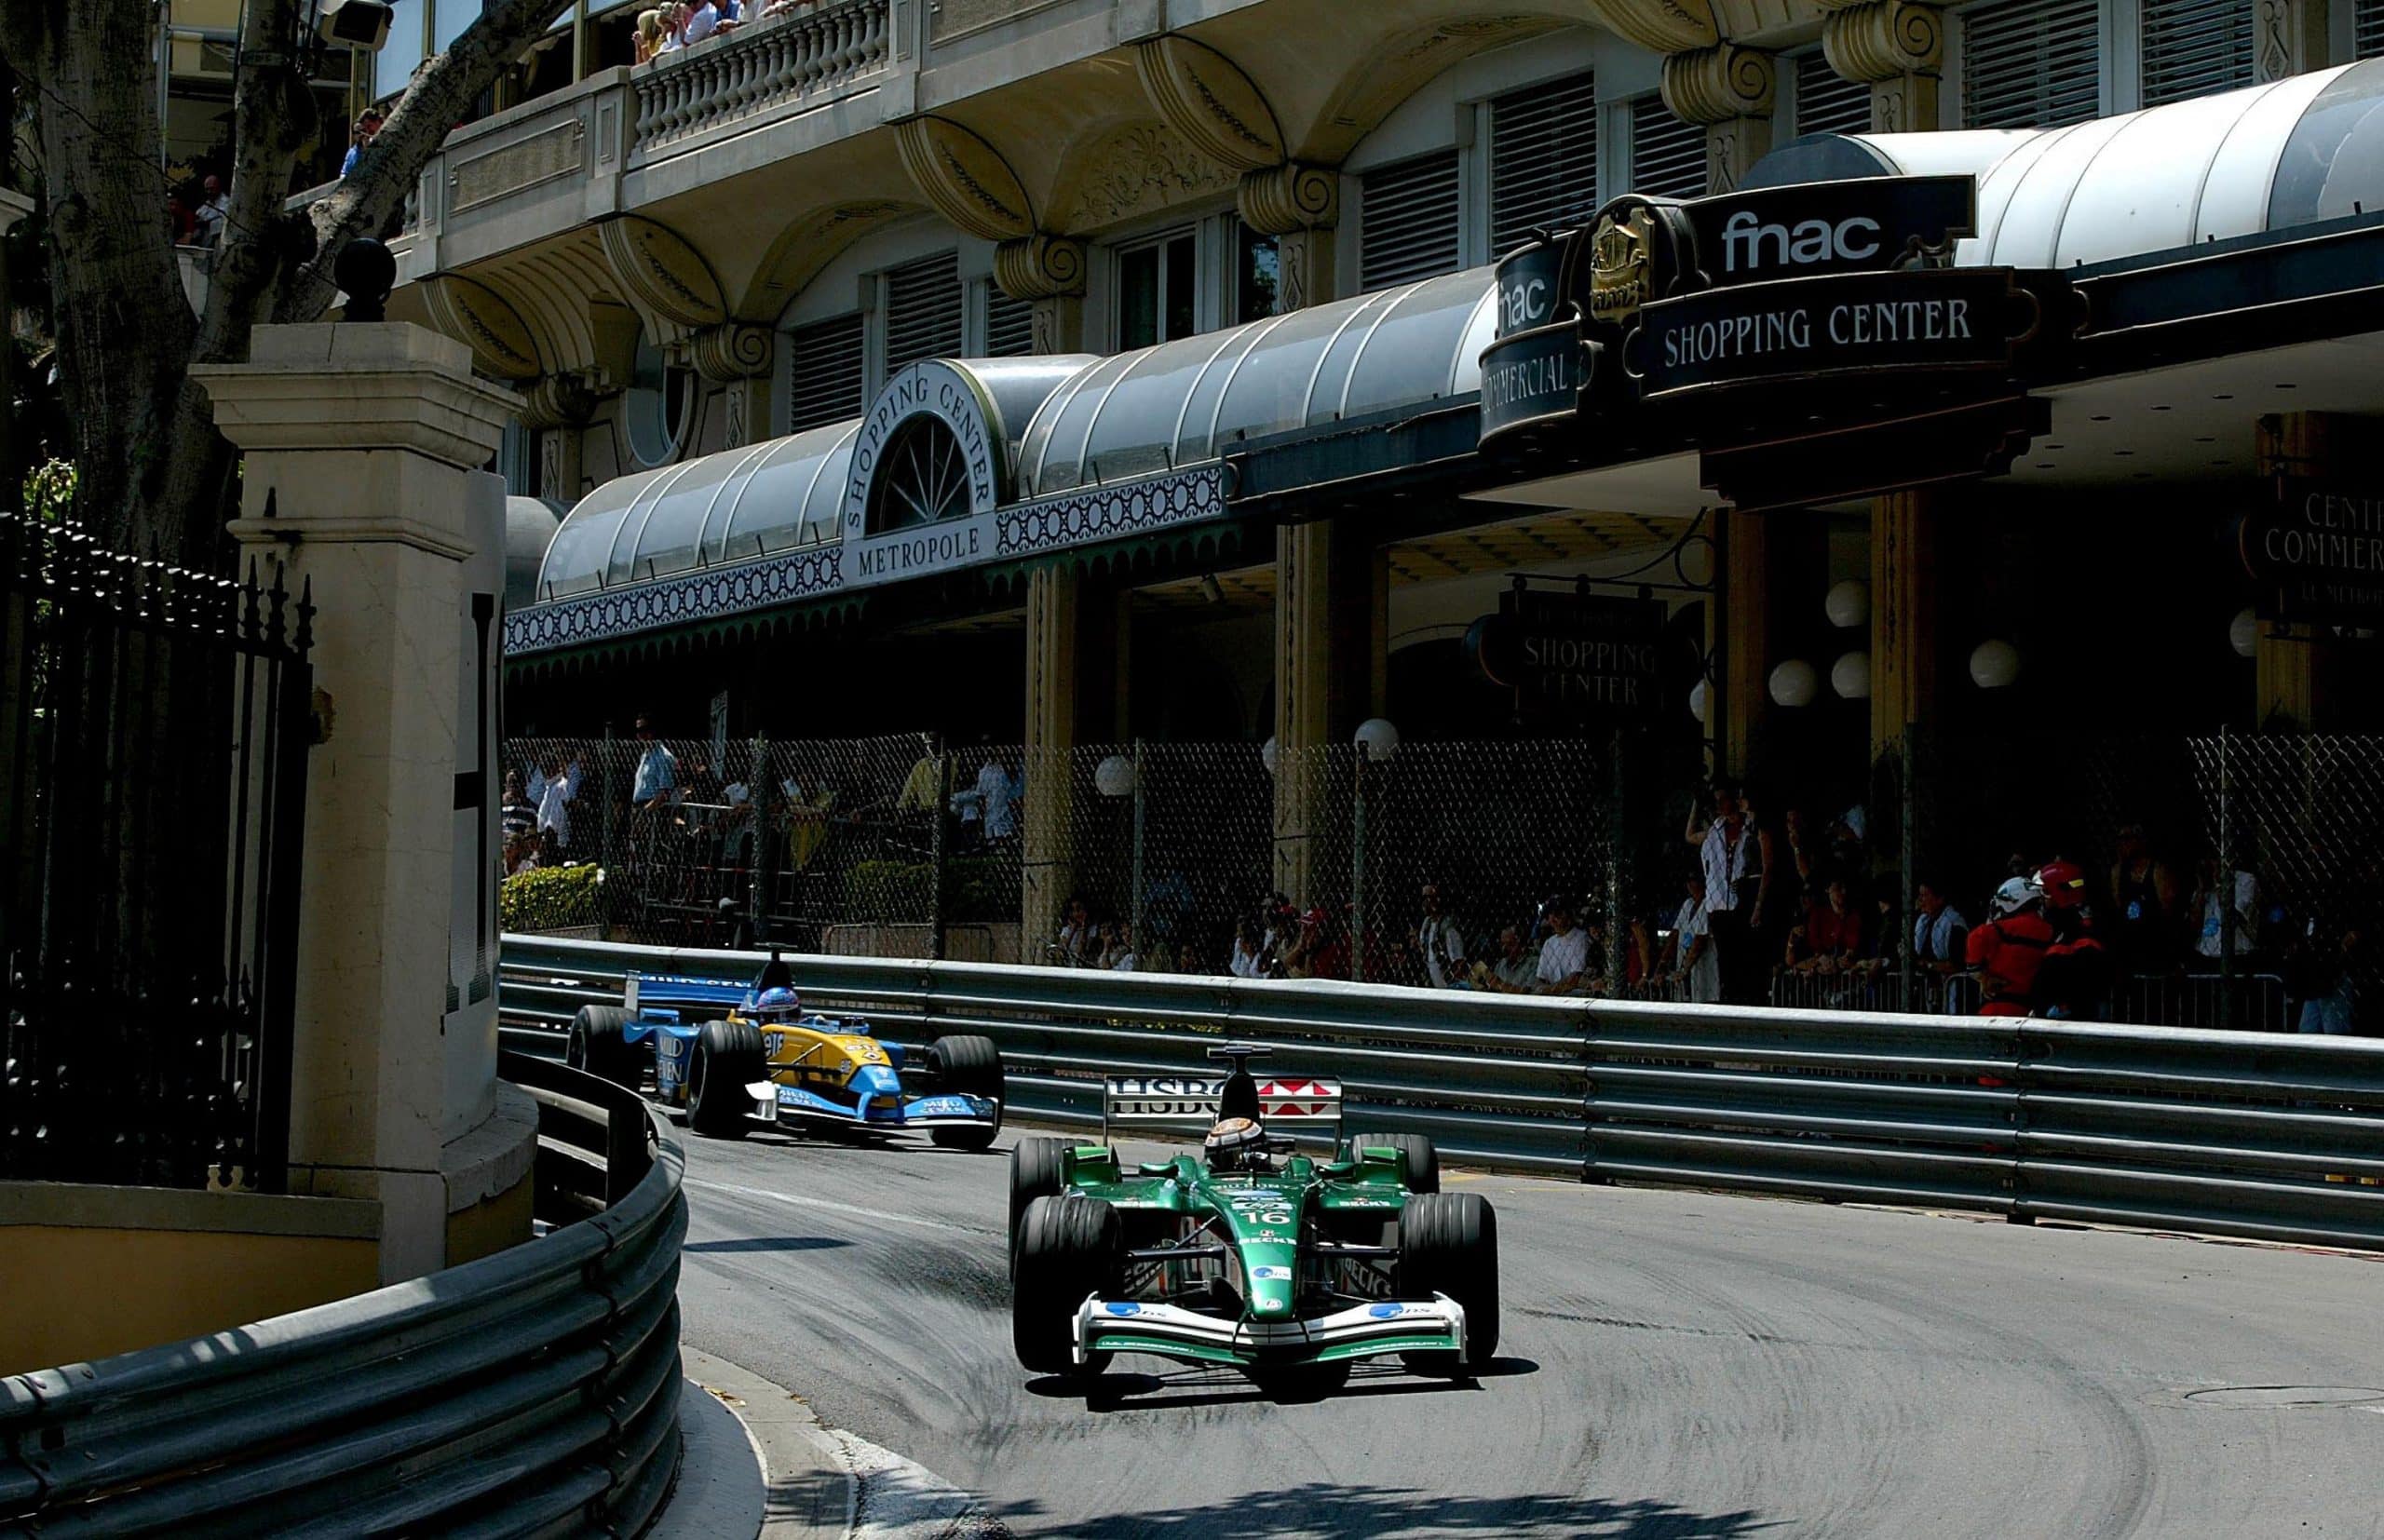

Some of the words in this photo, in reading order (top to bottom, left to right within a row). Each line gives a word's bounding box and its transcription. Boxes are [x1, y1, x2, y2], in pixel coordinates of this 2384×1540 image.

[1721, 210, 1880, 272] fnac
[1664, 308, 1810, 368] SHOPPING
[1828, 298, 1973, 345] CENTER
[847, 377, 928, 528] SHOPPING
[939, 383, 989, 503] CENTER
[859, 527, 979, 577] METROPOLE
[1524, 634, 1656, 675] SHOPPING
[1542, 671, 1640, 707] CENTER
[1240, 1211, 1291, 1225] 16
